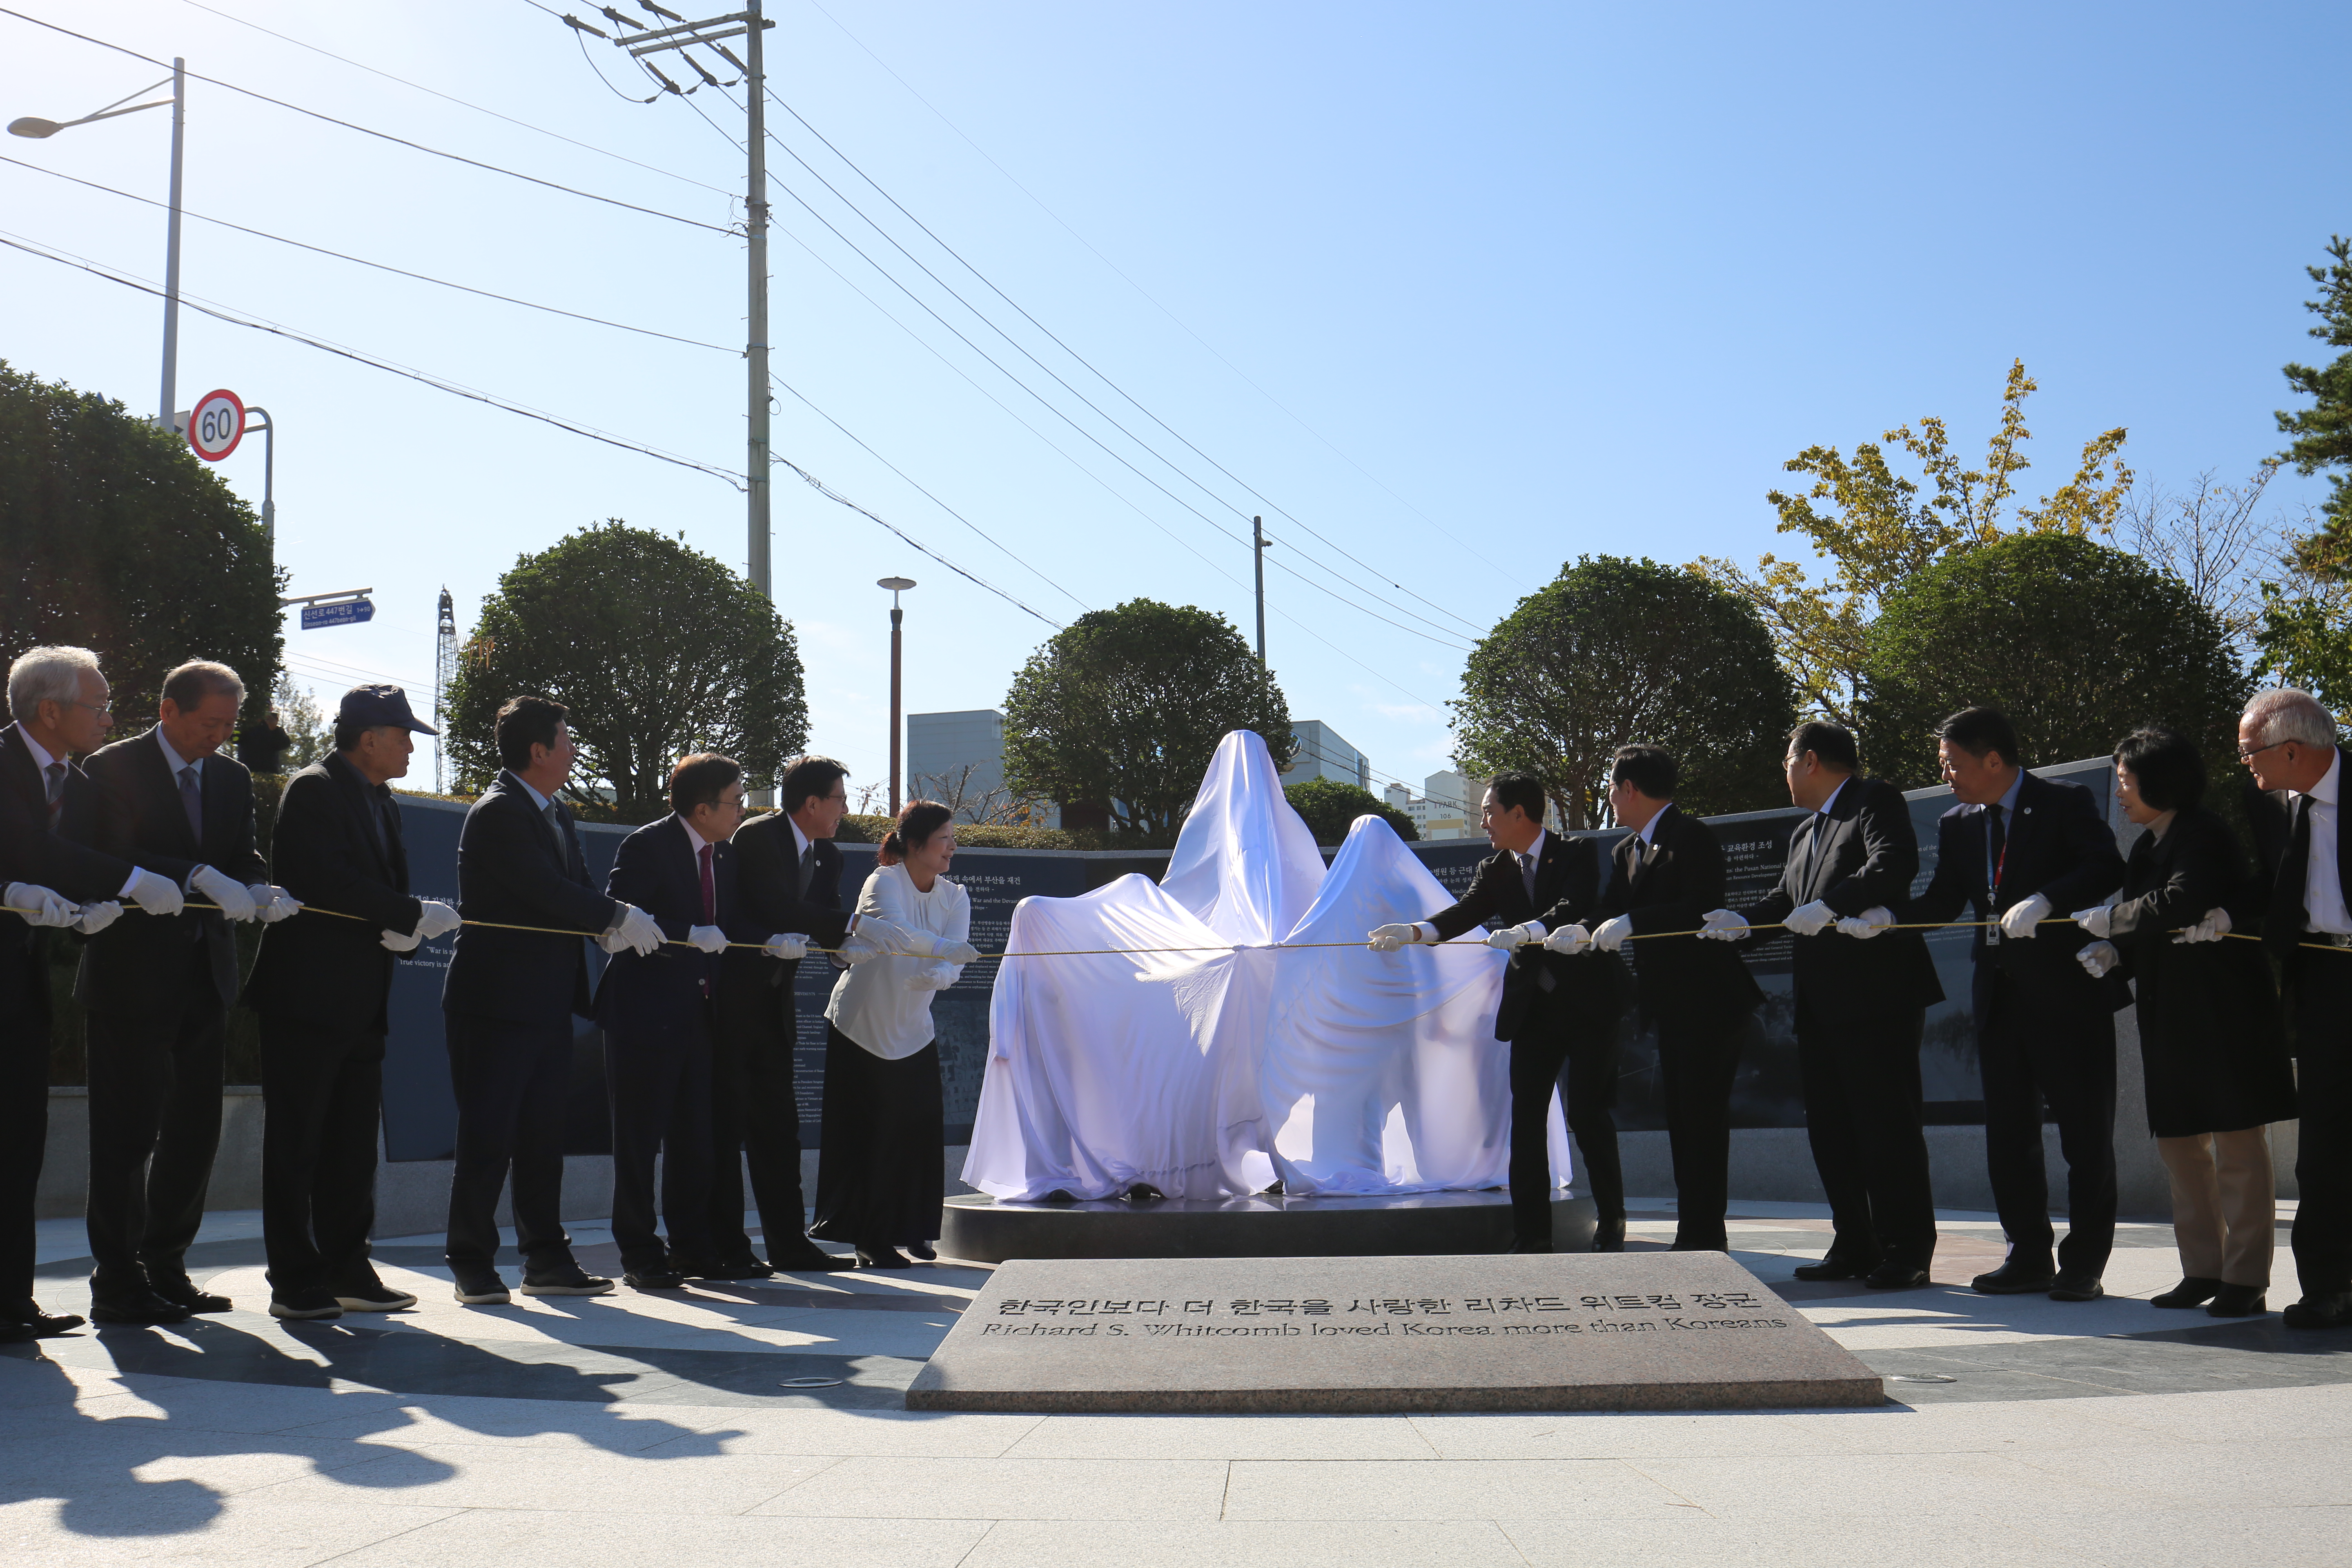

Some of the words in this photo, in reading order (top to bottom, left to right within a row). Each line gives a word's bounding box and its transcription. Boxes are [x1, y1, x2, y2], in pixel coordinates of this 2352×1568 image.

[203, 408, 231, 442] 60
[329, 616, 356, 624] 447beon-gil
[1727, 842, 1755, 852] 교육환경
[1758, 840, 1772, 849] 조성
[1459, 866, 1472, 874] 근대
[962, 875, 982, 884] 속에서
[984, 876, 1005, 884] 부산을
[414, 960, 434, 968] victory
[1000, 1299, 1170, 1316] 한국인보다
[1184, 1299, 1214, 1316] 더
[1230, 1299, 1334, 1316] 한국을
[1347, 1298, 1452, 1315] 사랑한
[1464, 1297, 1570, 1314] 리차드
[1580, 1294, 1686, 1312] 위트컴
[1689, 1293, 1762, 1309] 장군
[980, 1323, 1098, 1336] Richard
[1106, 1323, 1129, 1336] S.
[1143, 1323, 1301, 1336] Whitcomb
[1311, 1323, 1394, 1336] loved
[1400, 1323, 1495, 1336] Korea
[1502, 1324, 1583, 1335] more
[1589, 1319, 1662, 1333] than
[1662, 1317, 1788, 1330] Koreans
